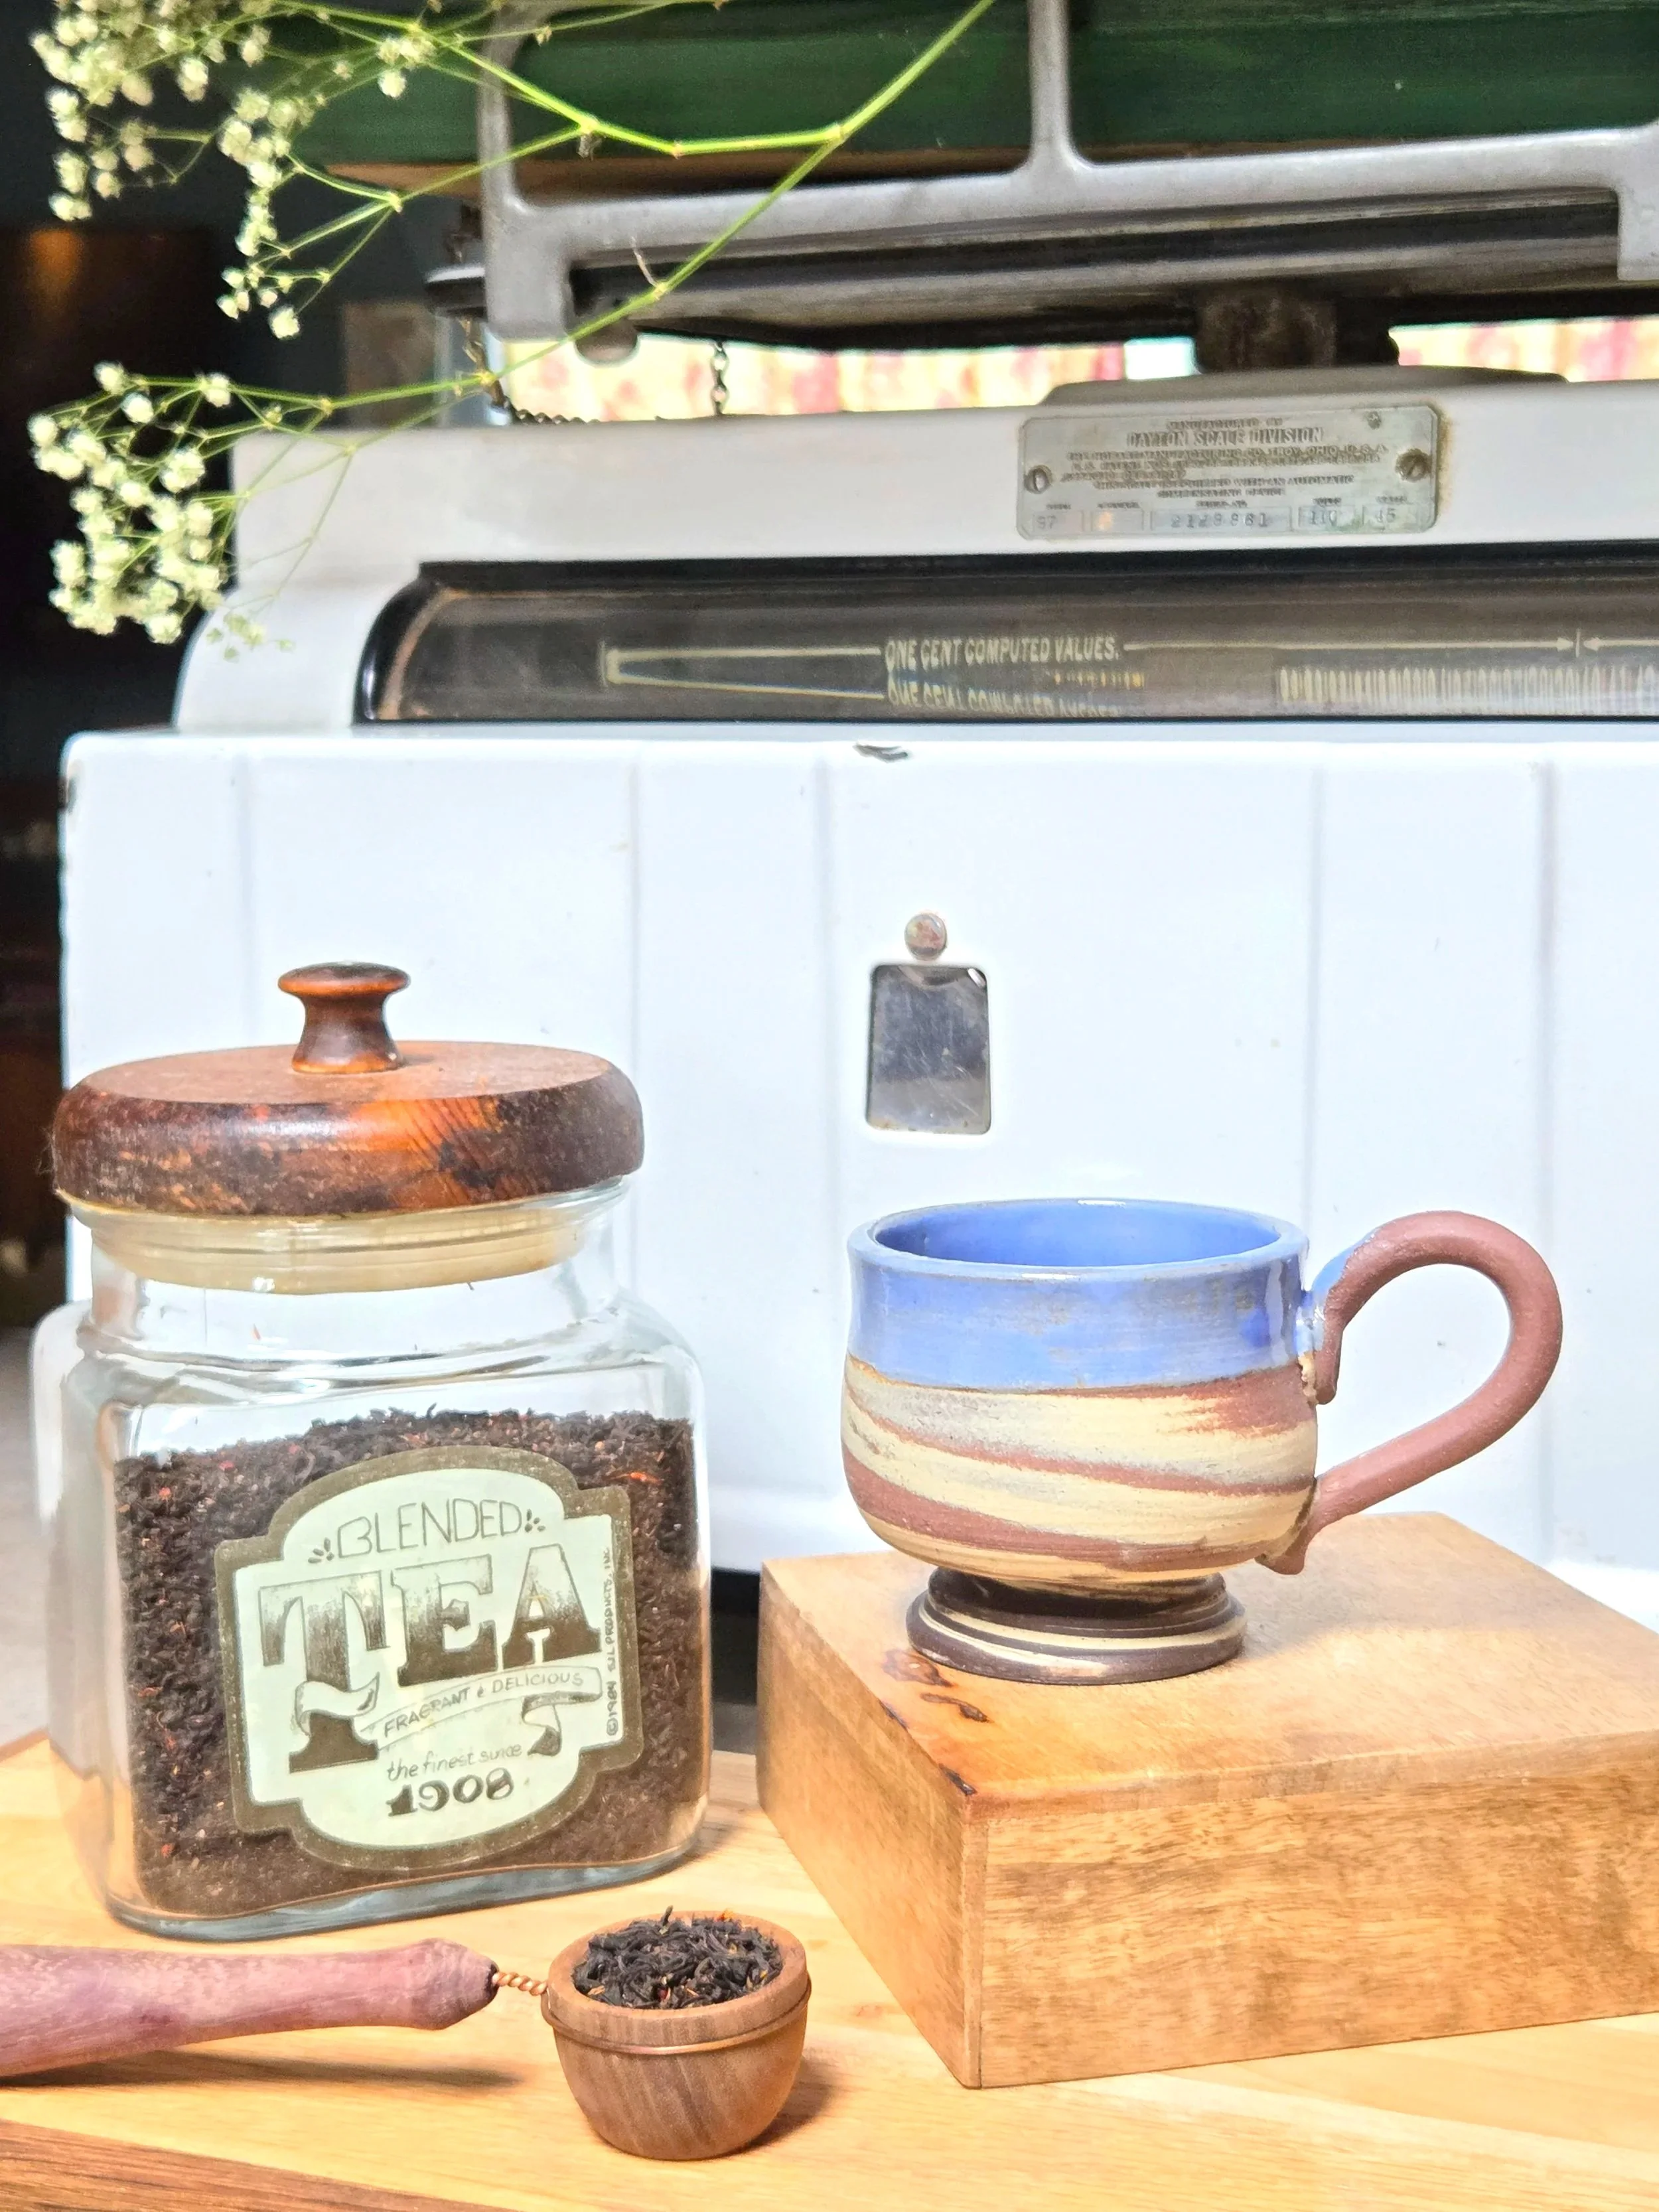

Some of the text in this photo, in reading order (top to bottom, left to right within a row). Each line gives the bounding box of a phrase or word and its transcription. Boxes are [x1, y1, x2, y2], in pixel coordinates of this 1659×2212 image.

[1126, 427, 1324, 447] DAYTON SCALE DIVISION
[885, 639, 917, 672] ONE
[920, 639, 962, 670] CENT
[964, 637, 1050, 666] COMPUTED
[338, 1498, 522, 1560] BLENDED
[258, 1543, 601, 1774] TEA
[384, 1688, 471, 1737] FRAGRANT
[491, 1672, 584, 1696] DELICIOUS
[387, 1760, 419, 1781] the
[421, 1751, 475, 1777] finest
